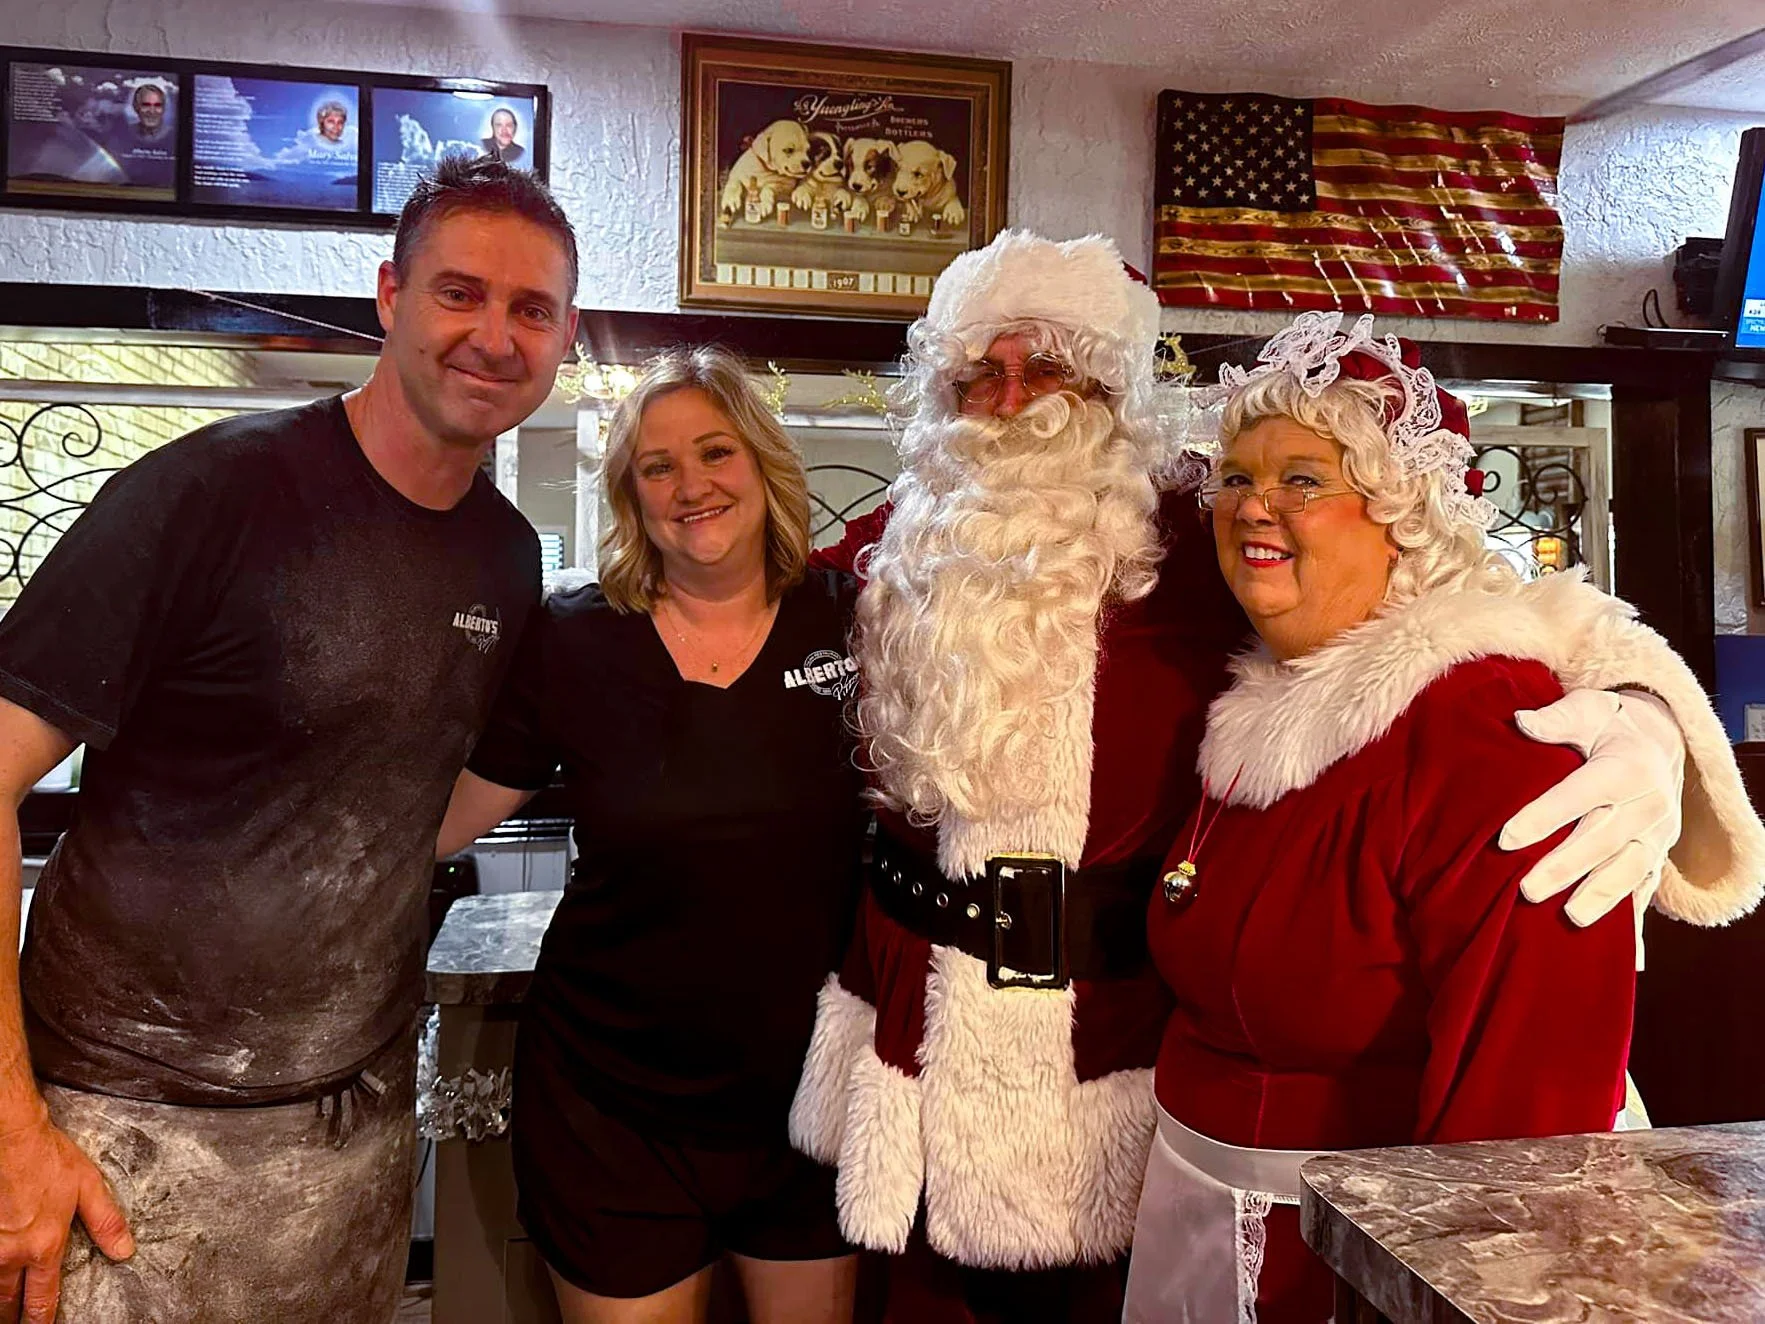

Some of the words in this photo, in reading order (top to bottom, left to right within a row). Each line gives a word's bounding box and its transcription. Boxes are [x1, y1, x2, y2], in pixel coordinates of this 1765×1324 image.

[799, 94, 874, 123] Yuengling
[452, 611, 498, 636] ALBERTO'S
[784, 656, 860, 689] ALBERTO
